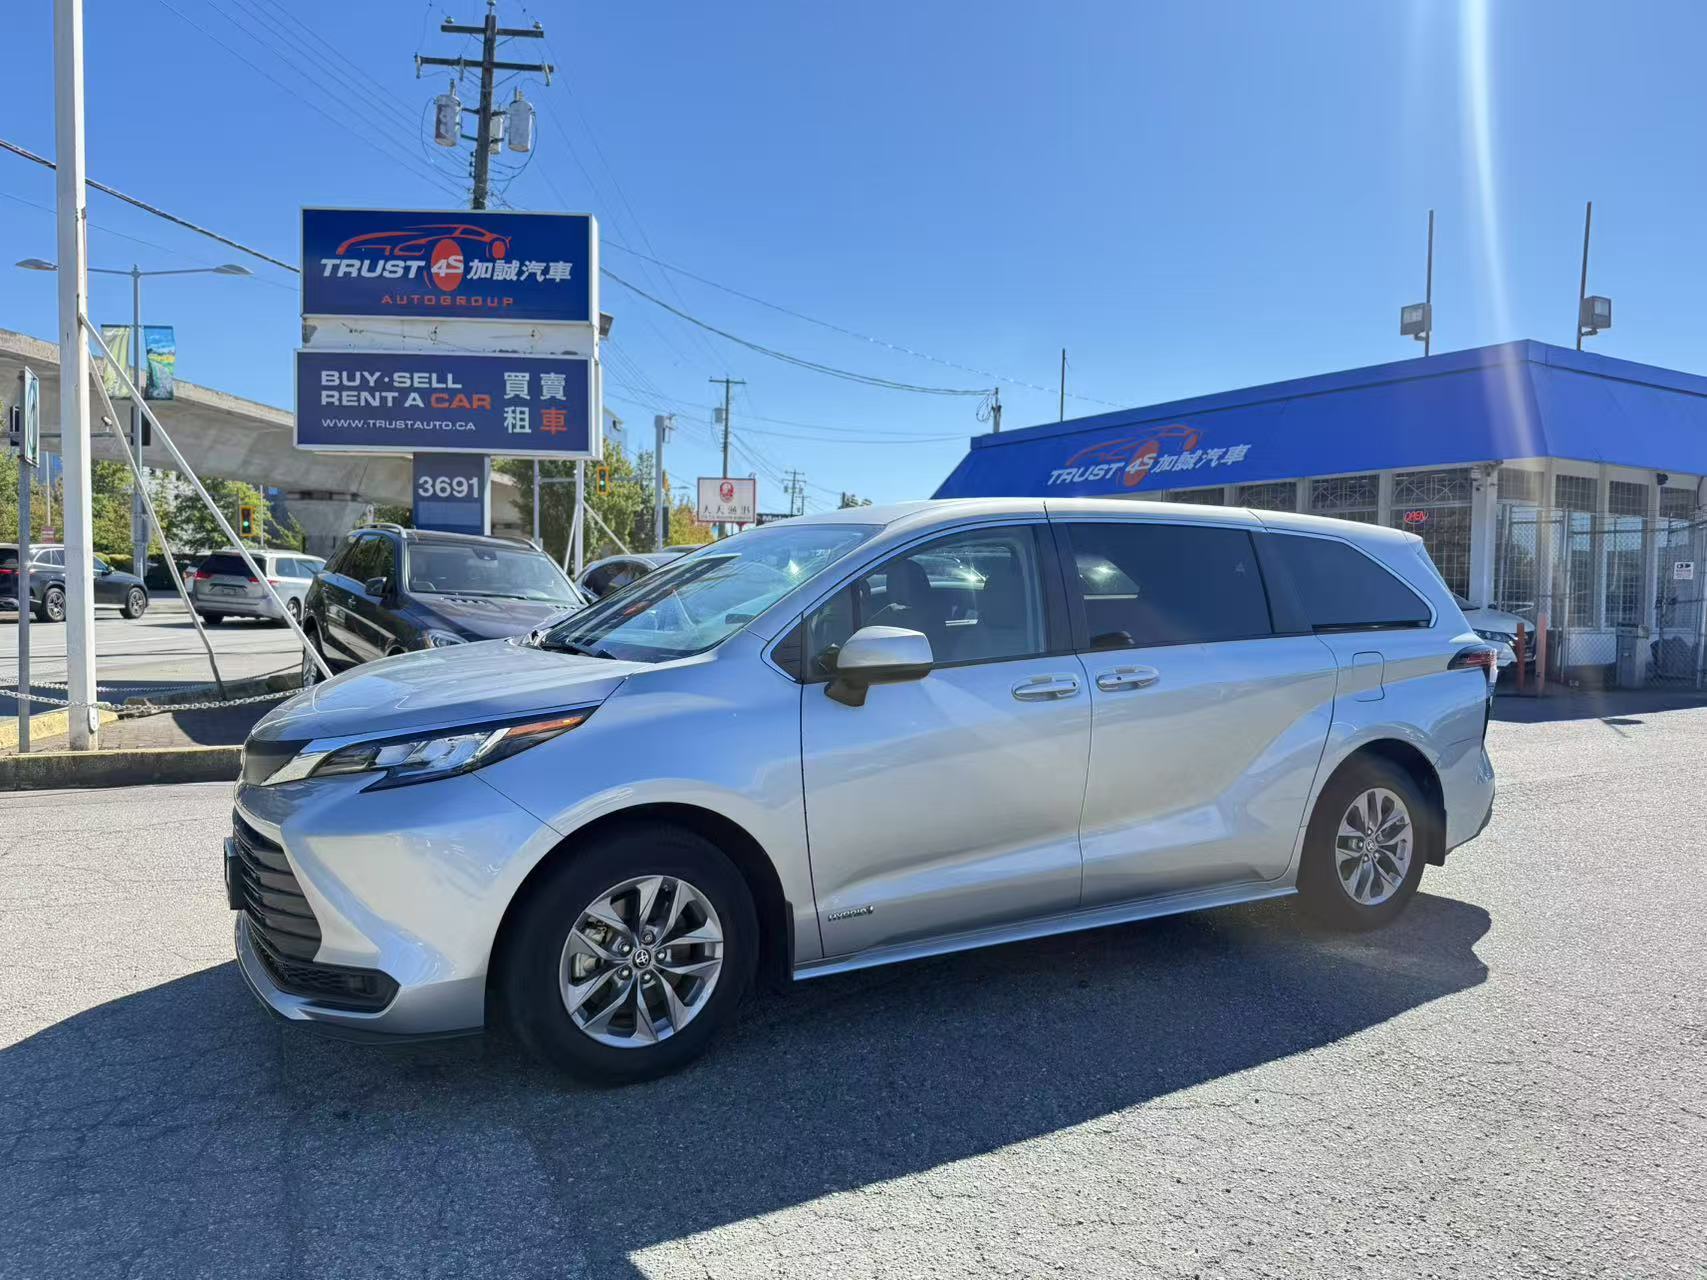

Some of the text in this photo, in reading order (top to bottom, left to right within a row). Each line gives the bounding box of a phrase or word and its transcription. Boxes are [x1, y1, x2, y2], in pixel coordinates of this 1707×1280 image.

[320, 255, 572, 282] TRUST 4S 加誠汽車
[381, 295, 513, 307] AUTOGROUP
[321, 391, 492, 410] RENT A CAR
[321, 418, 476, 431] WWW.TRUSTAUTO.CA
[1047, 462, 1125, 486] TRUST
[1150, 444, 1252, 473] 加誠汽車
[418, 476, 480, 498] 3691
